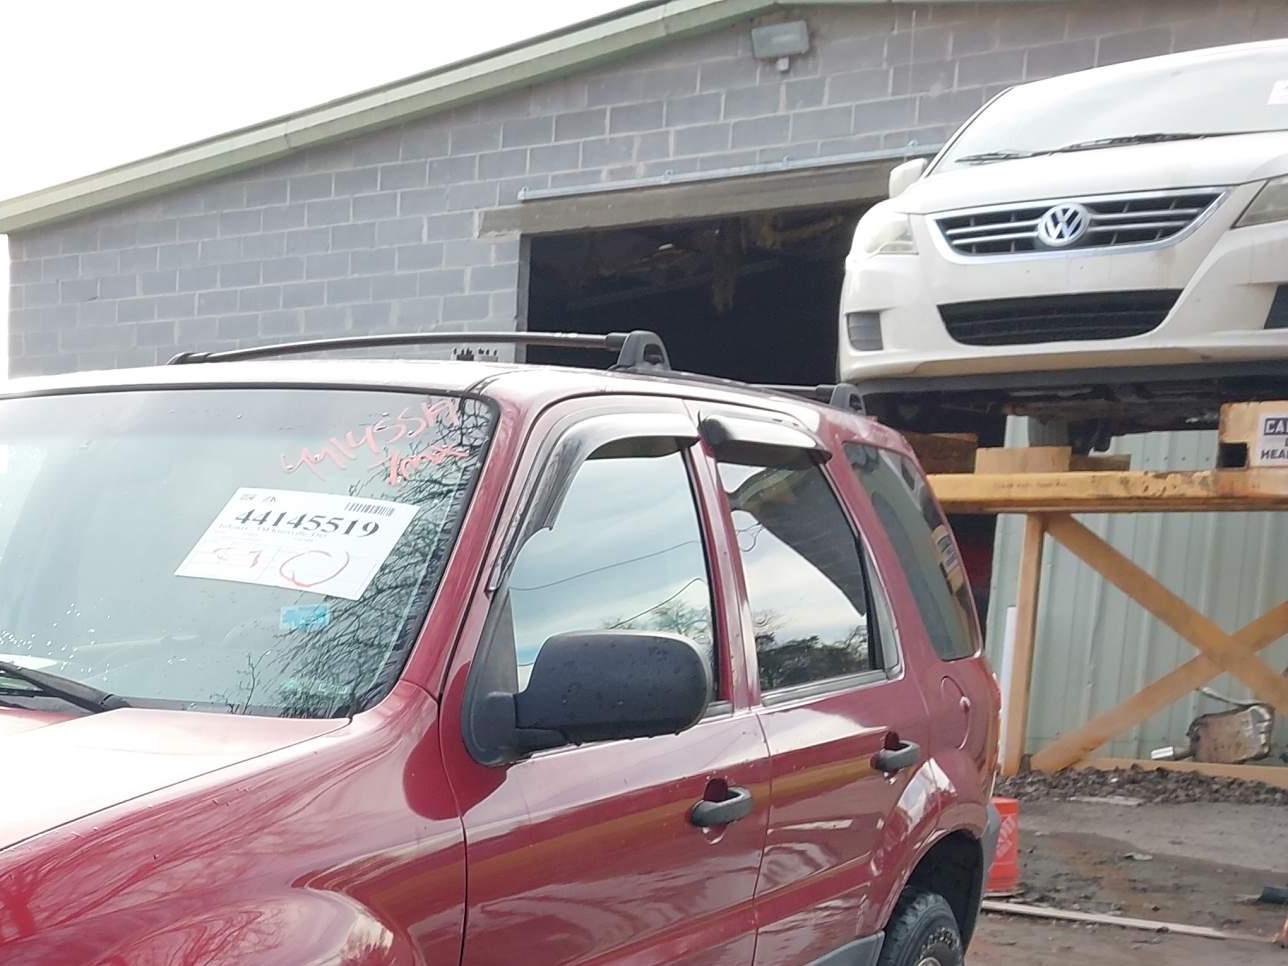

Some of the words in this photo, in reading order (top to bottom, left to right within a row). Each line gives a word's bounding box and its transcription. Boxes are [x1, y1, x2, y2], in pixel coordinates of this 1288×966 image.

[1042, 205, 1085, 243] VW
[1265, 419, 1288, 433] CA
[1261, 448, 1288, 460] HEA
[235, 508, 380, 538] 44145519
